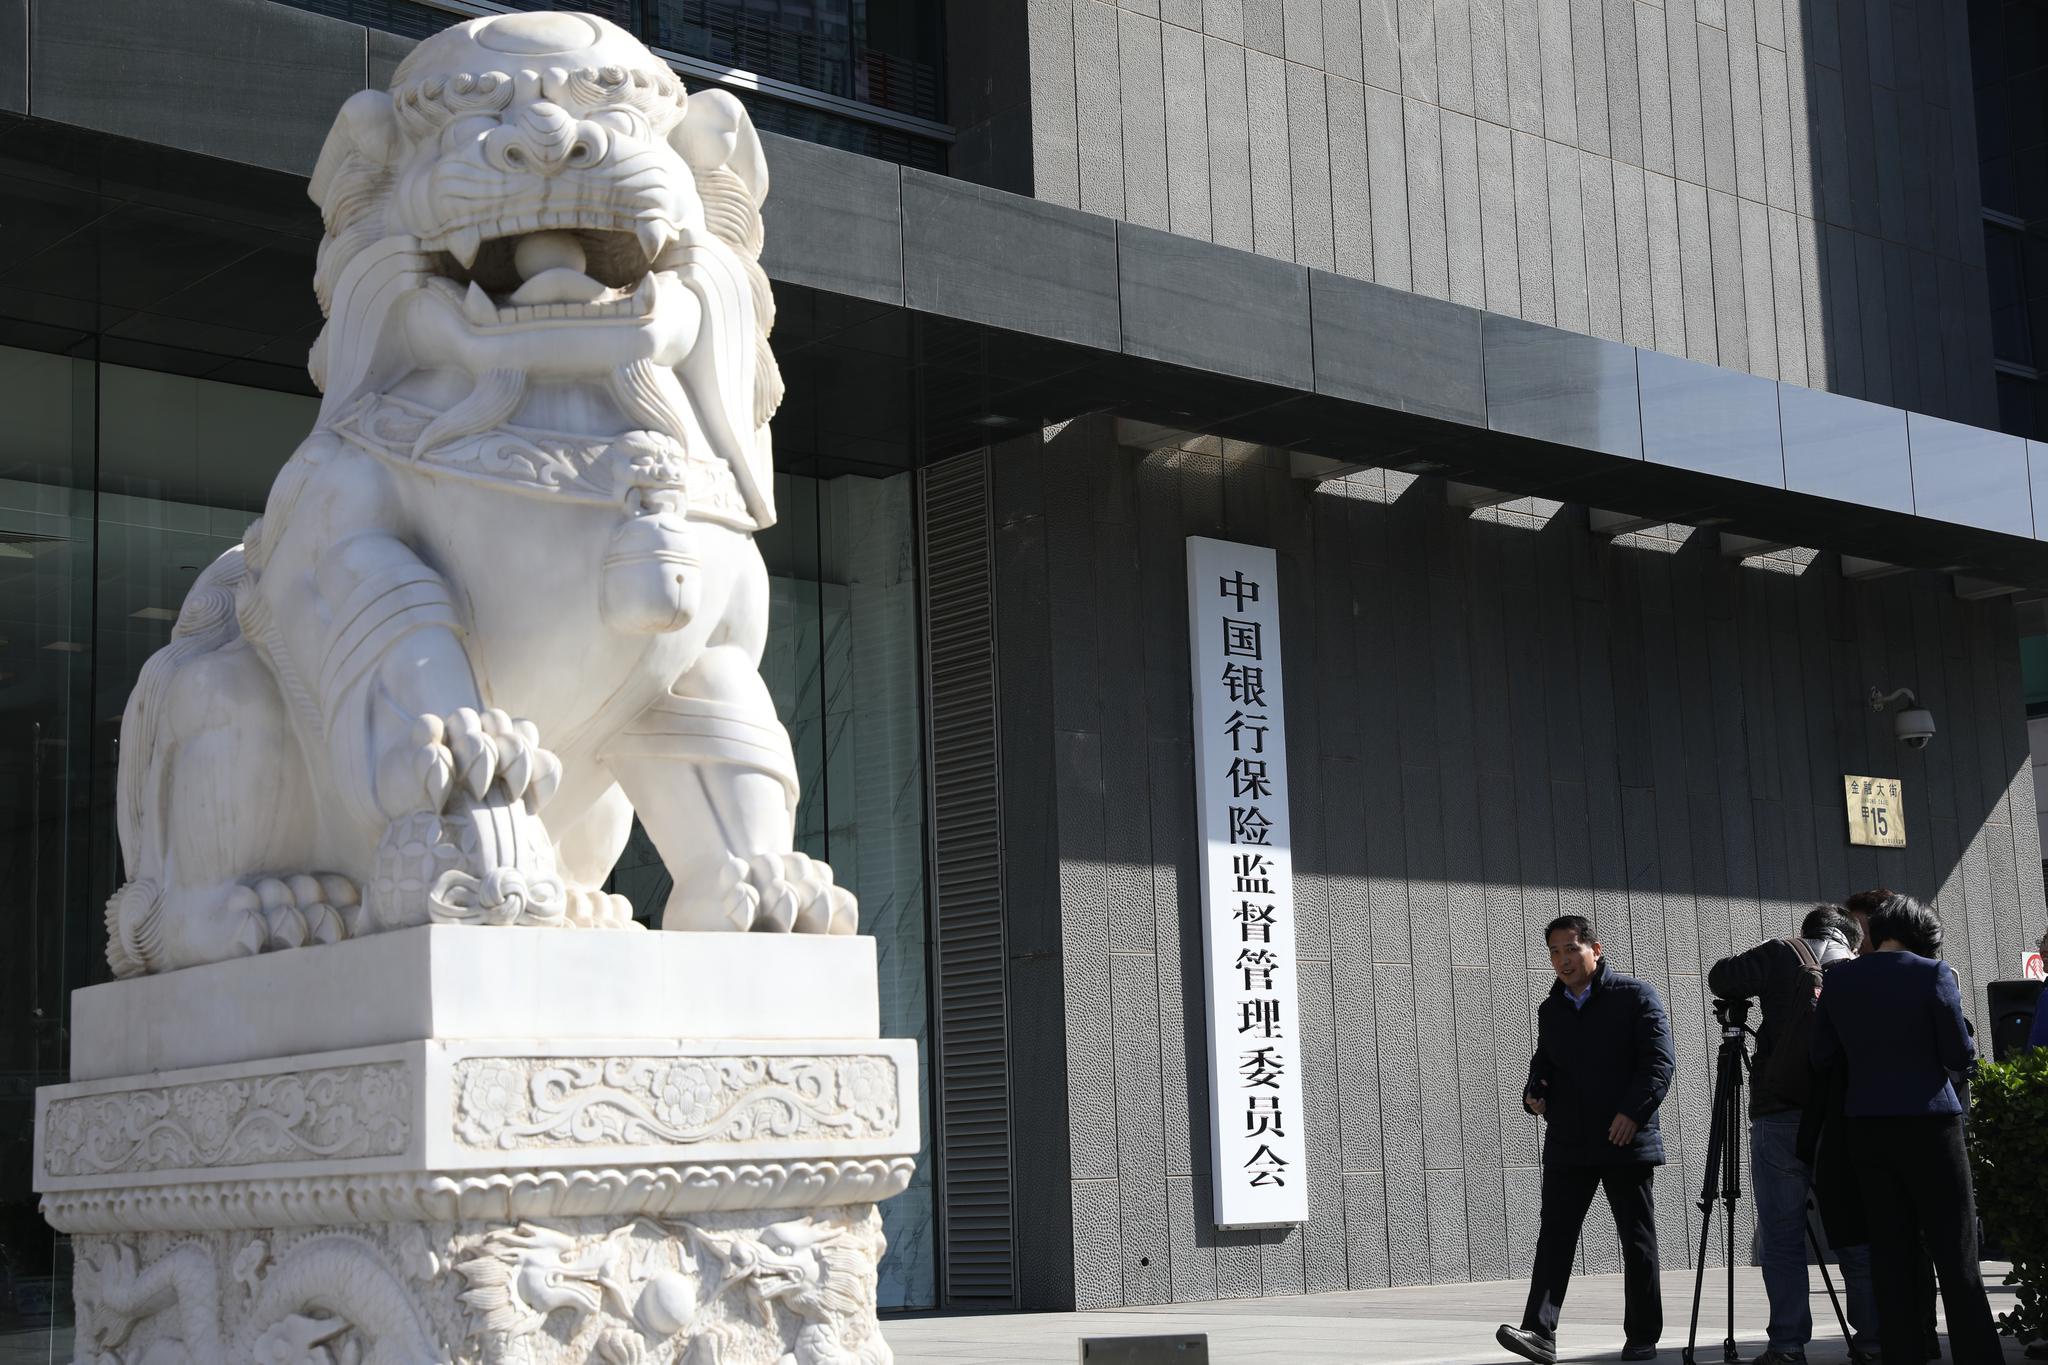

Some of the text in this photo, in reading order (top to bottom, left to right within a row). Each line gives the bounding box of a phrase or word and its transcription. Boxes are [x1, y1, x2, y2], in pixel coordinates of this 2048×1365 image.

[1219, 570, 1289, 1188] 中国银行保险监督管理委员会
